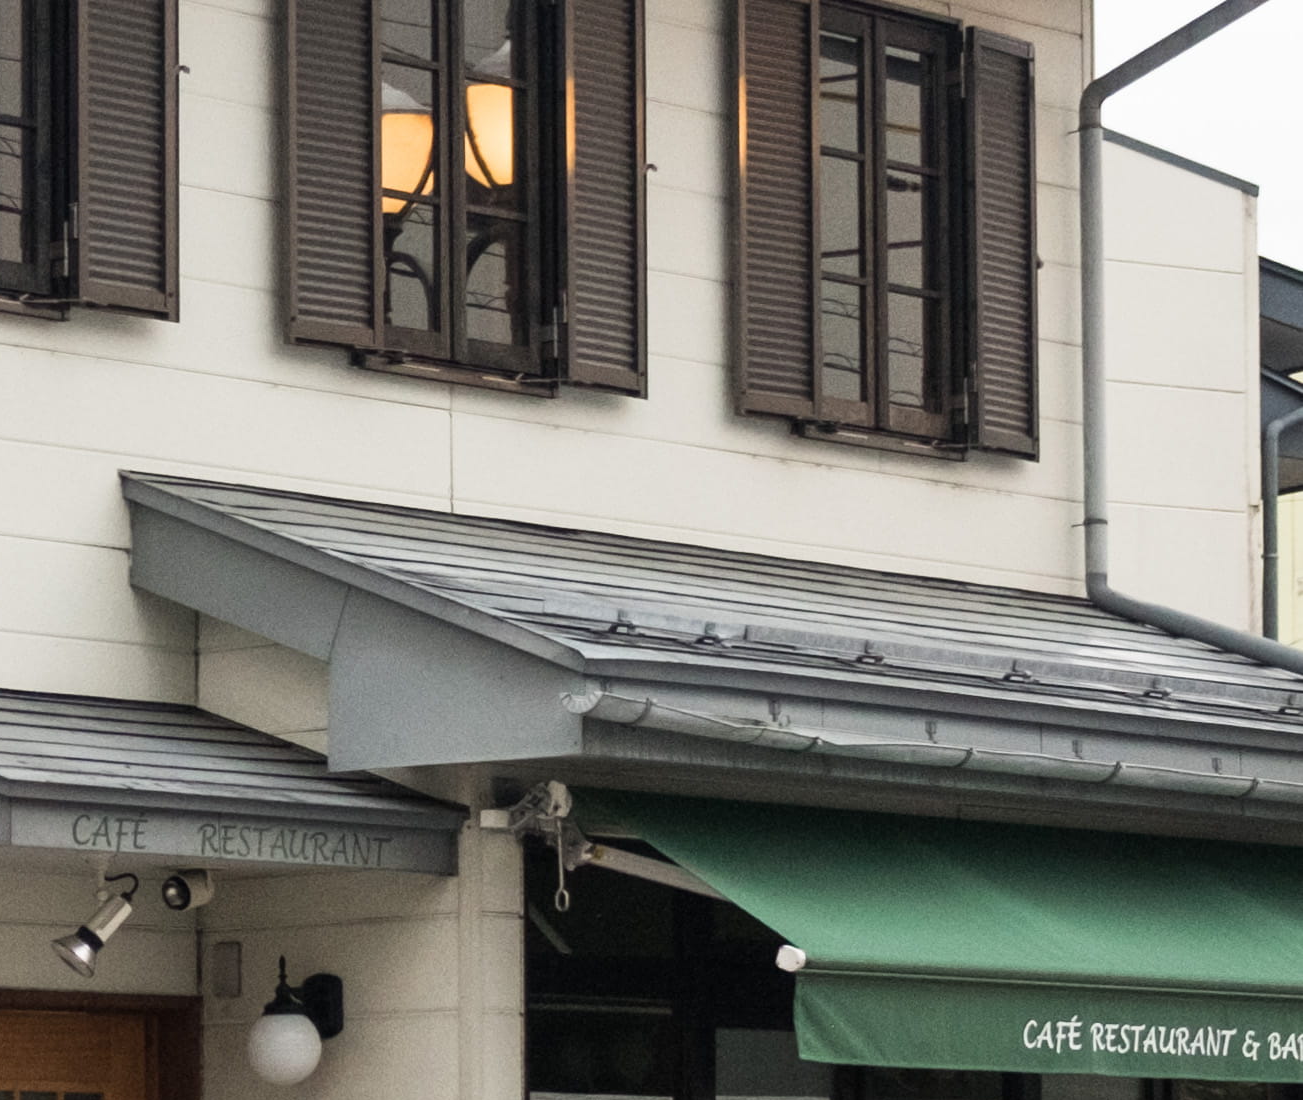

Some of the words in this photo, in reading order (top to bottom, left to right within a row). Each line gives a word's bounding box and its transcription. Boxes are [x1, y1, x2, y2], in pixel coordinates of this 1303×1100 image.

[71, 812, 148, 851] CAFÉ
[197, 823, 392, 866] RESTAURANT
[1023, 1014, 1083, 1054] CAFÉ
[1090, 1022, 1238, 1058] RESTAURANT
[1241, 1030, 1261, 1061] &
